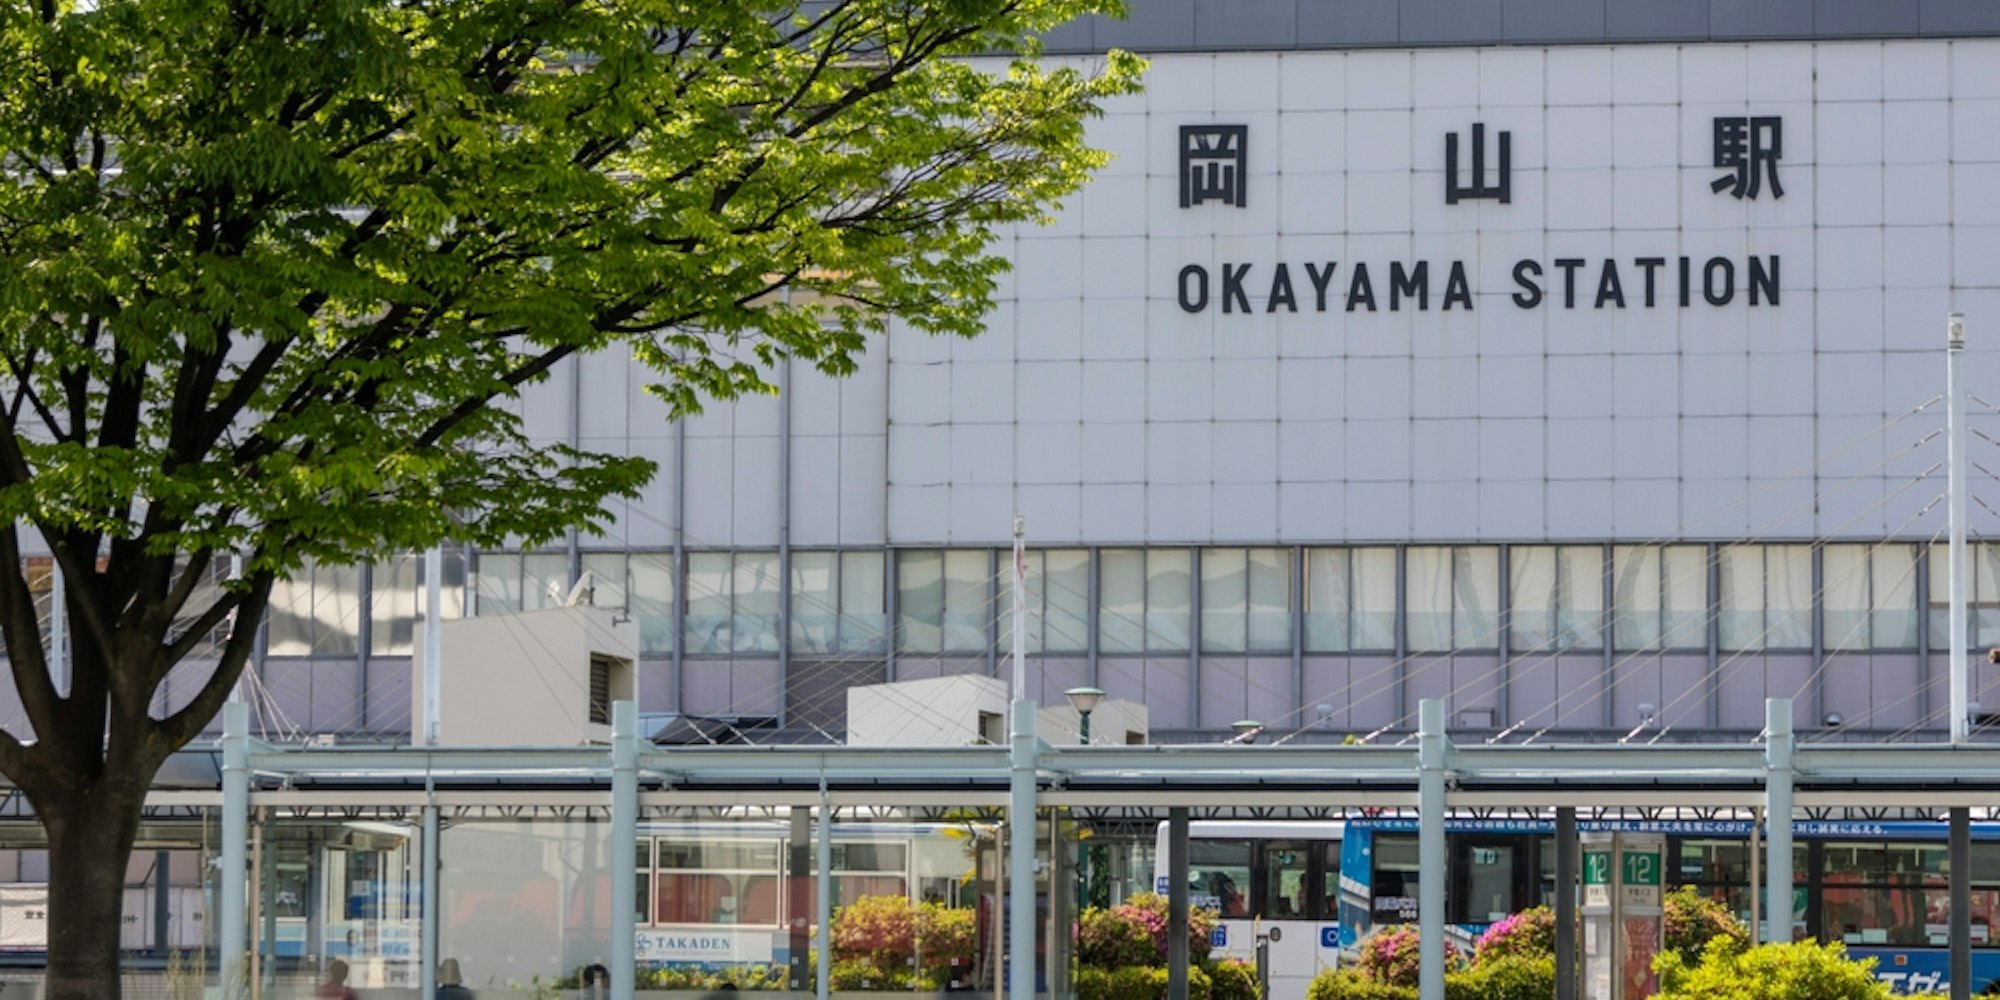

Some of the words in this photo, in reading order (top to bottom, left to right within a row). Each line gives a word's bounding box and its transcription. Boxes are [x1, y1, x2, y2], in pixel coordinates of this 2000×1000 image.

[1178, 261, 1473, 313] OKAYAMA
[1512, 255, 1780, 309] STATION
[1589, 854, 1607, 882] 12
[1627, 855, 1651, 883] 12
[656, 937, 731, 949] TAKADEN
